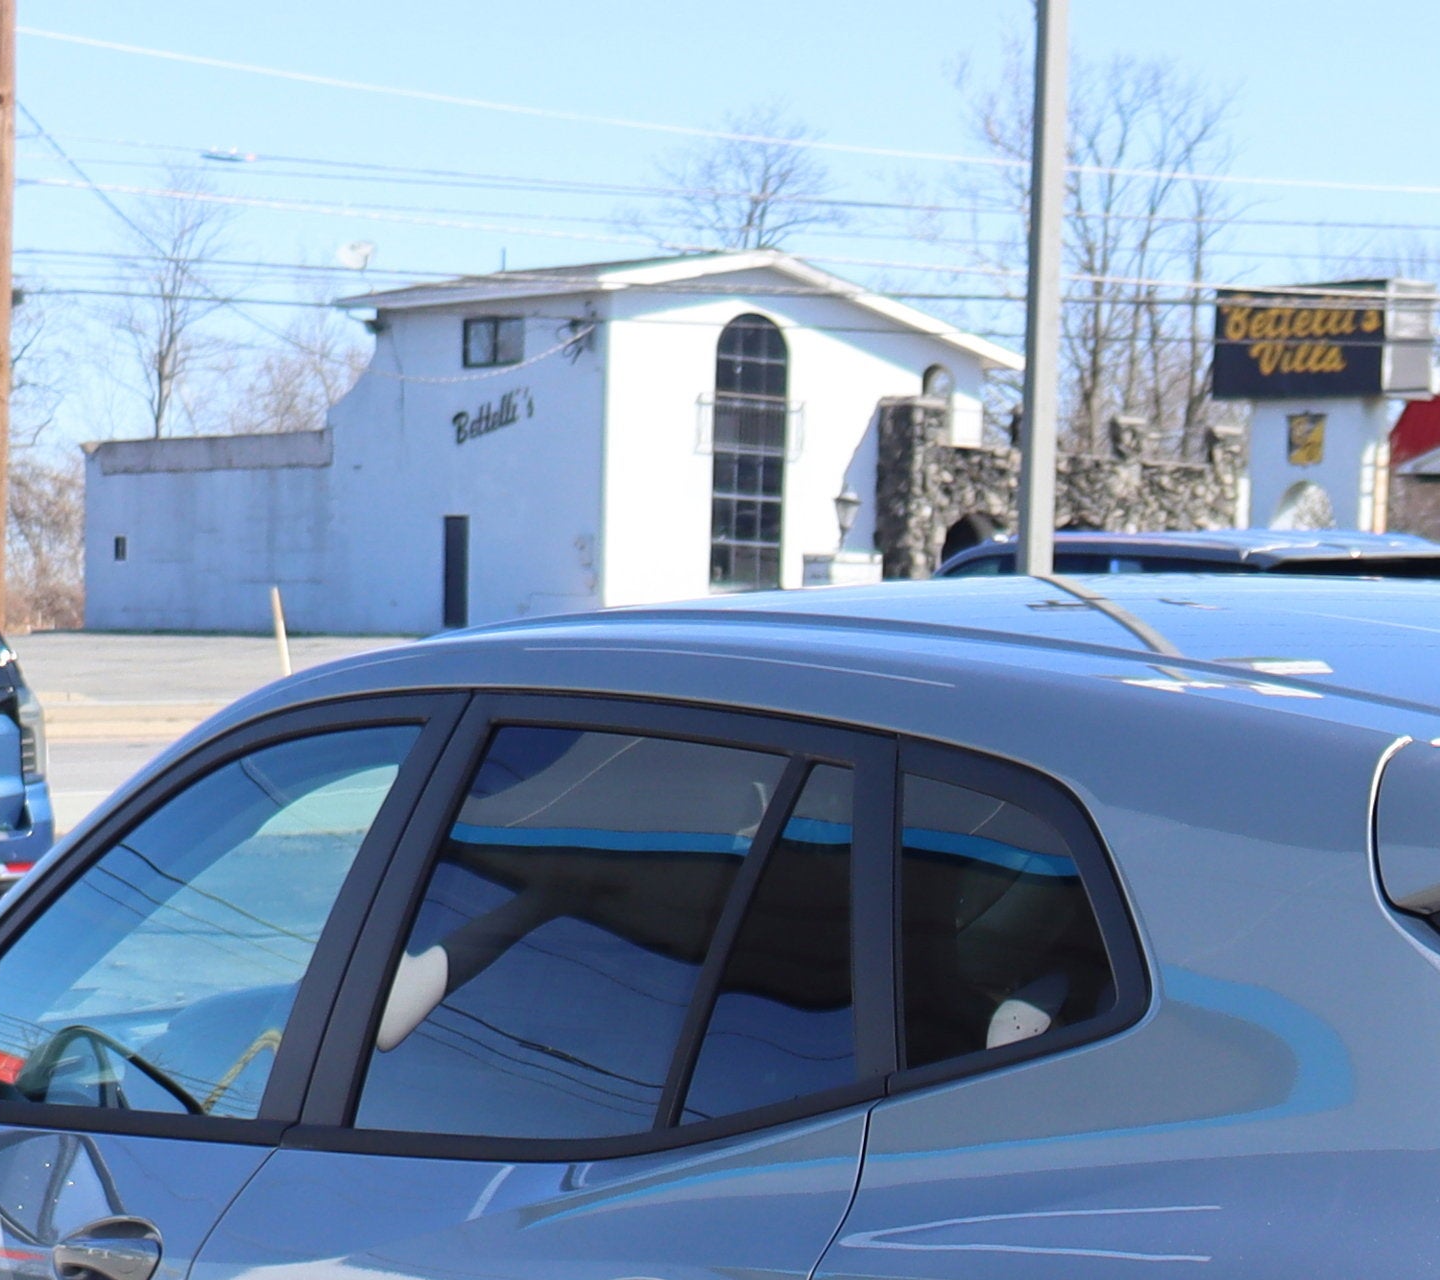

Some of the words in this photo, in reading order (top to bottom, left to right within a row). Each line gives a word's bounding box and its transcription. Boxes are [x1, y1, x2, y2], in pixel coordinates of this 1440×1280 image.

[1221, 289, 1383, 341] Bettelli's
[1249, 340, 1348, 375] Villa
[452, 387, 534, 444] Bettelli's
